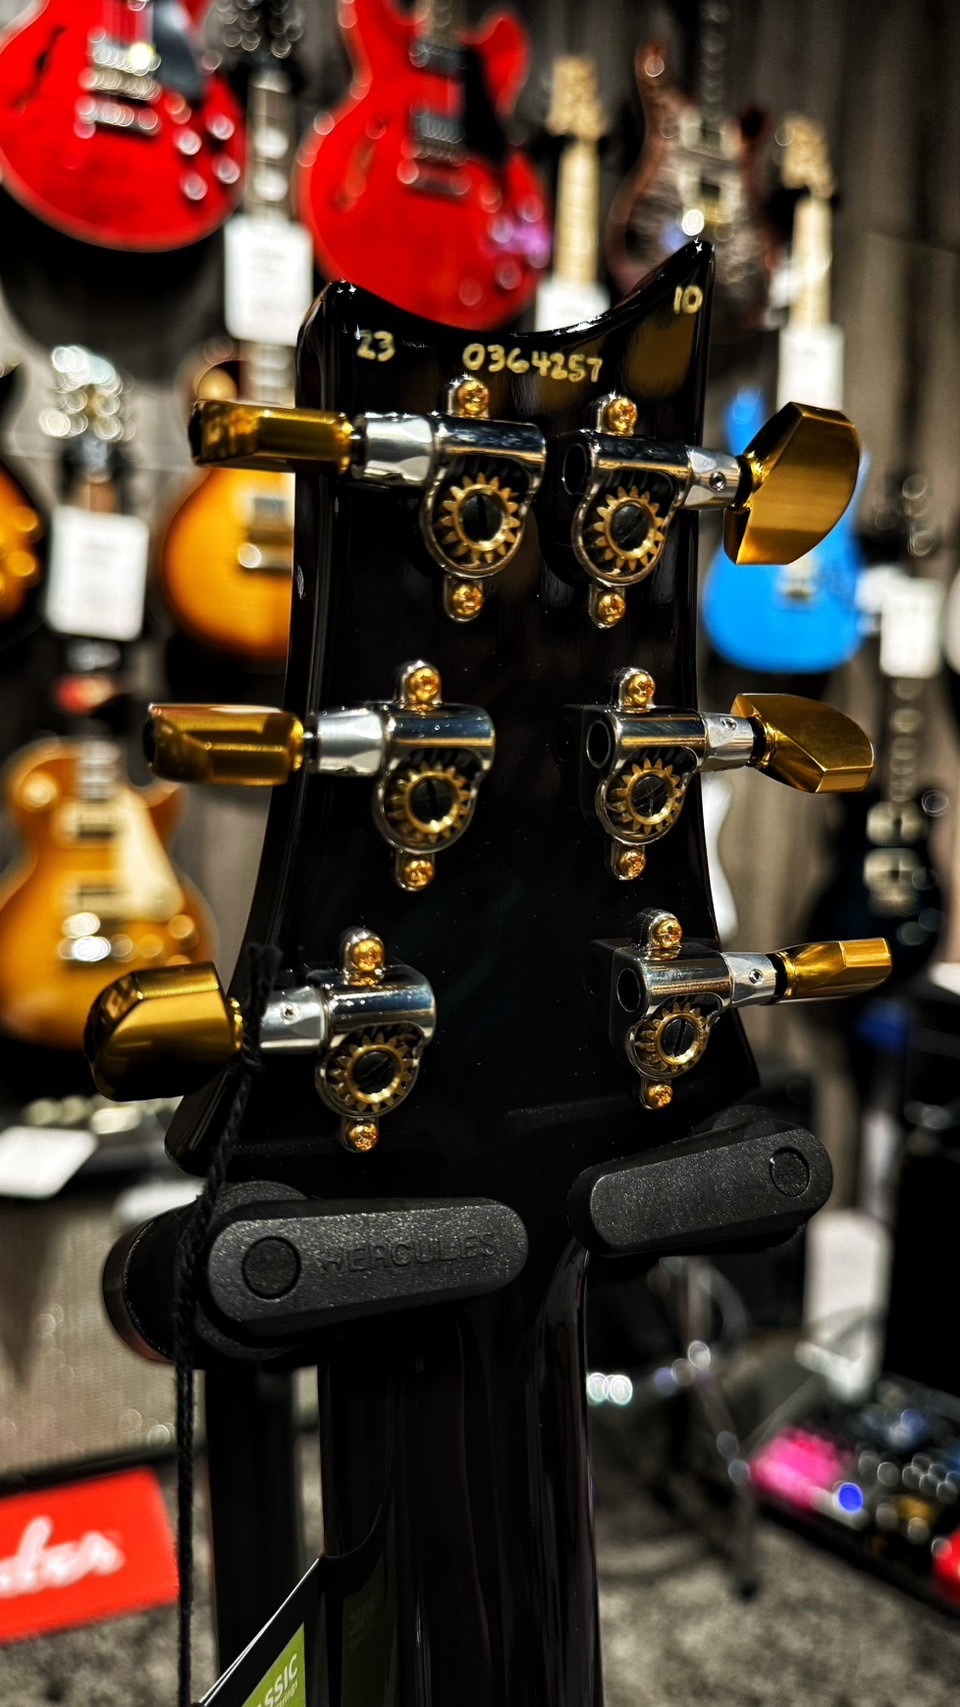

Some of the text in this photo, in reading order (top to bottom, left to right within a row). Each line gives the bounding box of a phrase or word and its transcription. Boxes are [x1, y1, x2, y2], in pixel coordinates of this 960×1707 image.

[673, 285, 704, 315] 10
[356, 330, 604, 383] 23 0364257
[324, 1232, 497, 1273] HERCULES
